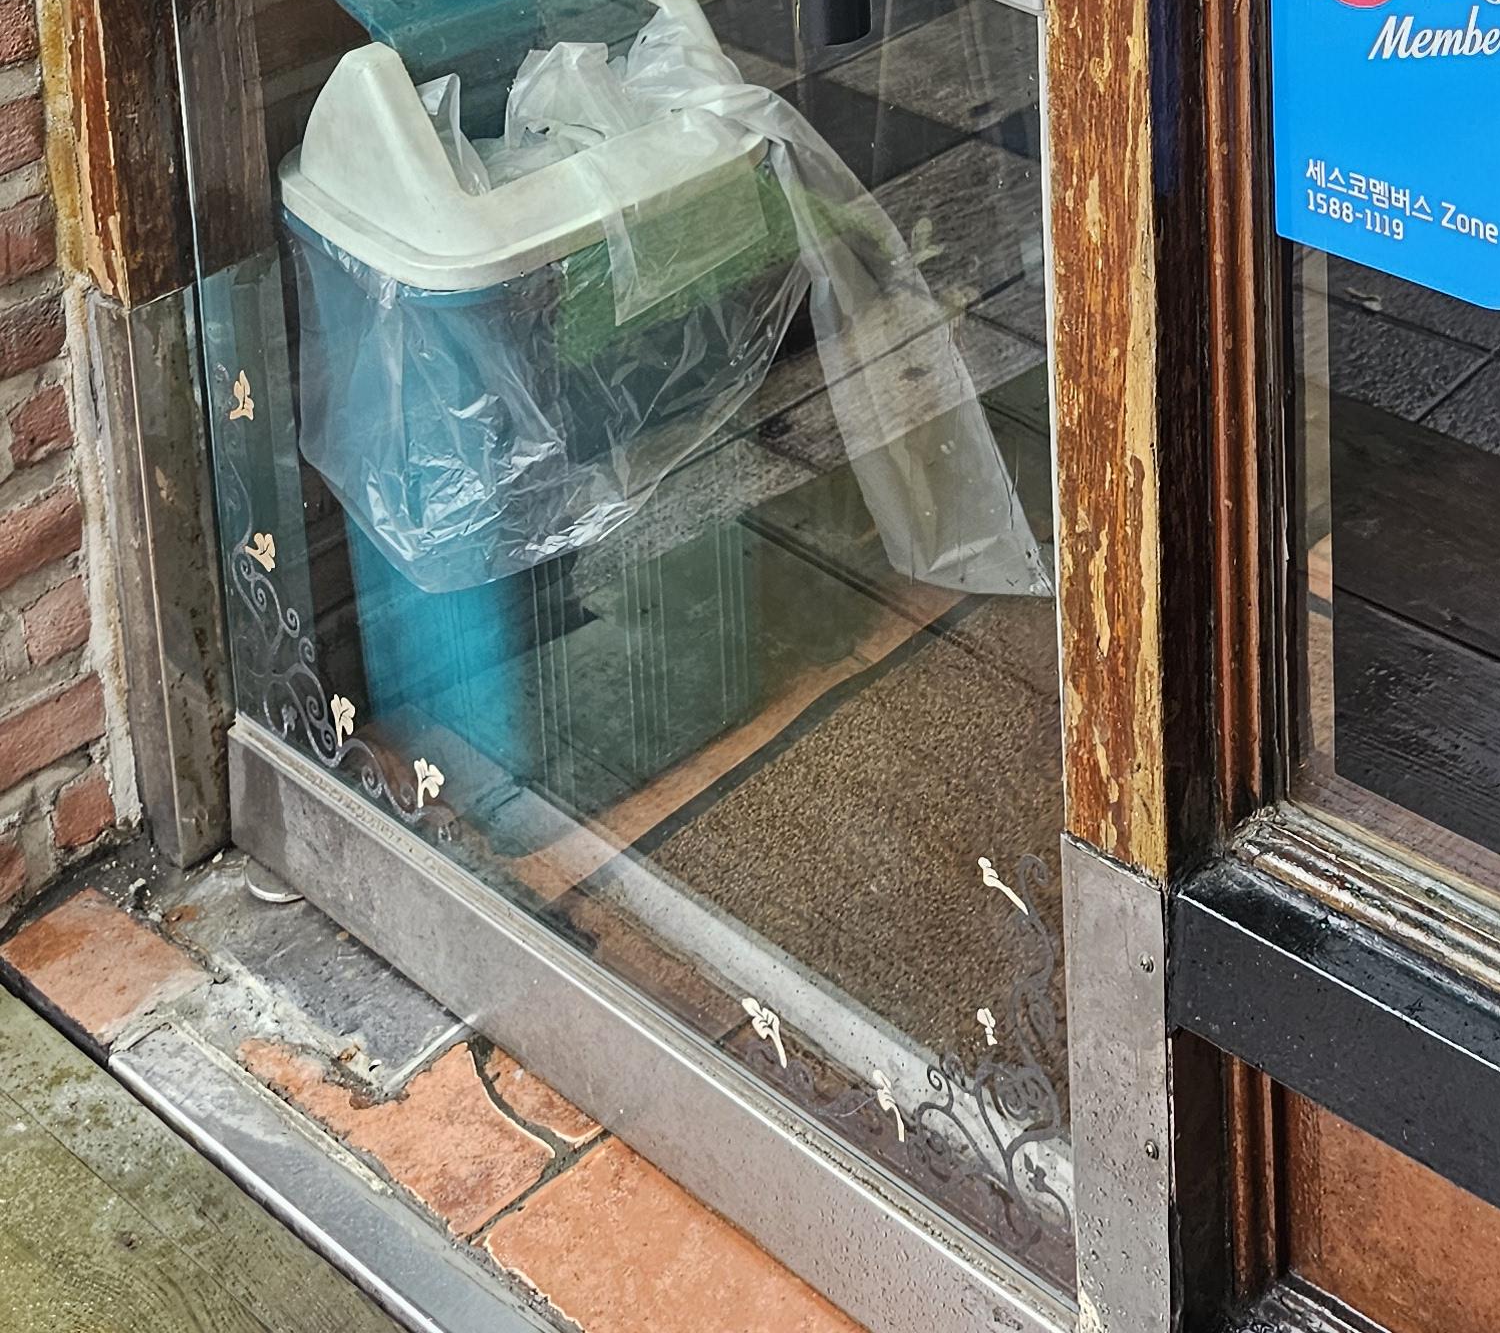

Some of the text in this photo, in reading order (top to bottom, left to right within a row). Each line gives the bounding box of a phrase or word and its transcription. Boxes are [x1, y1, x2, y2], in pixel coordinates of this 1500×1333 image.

[1305, 157, 1500, 247] 세스코멤버스 Zone
[1306, 189, 1405, 242] 1588-1119
